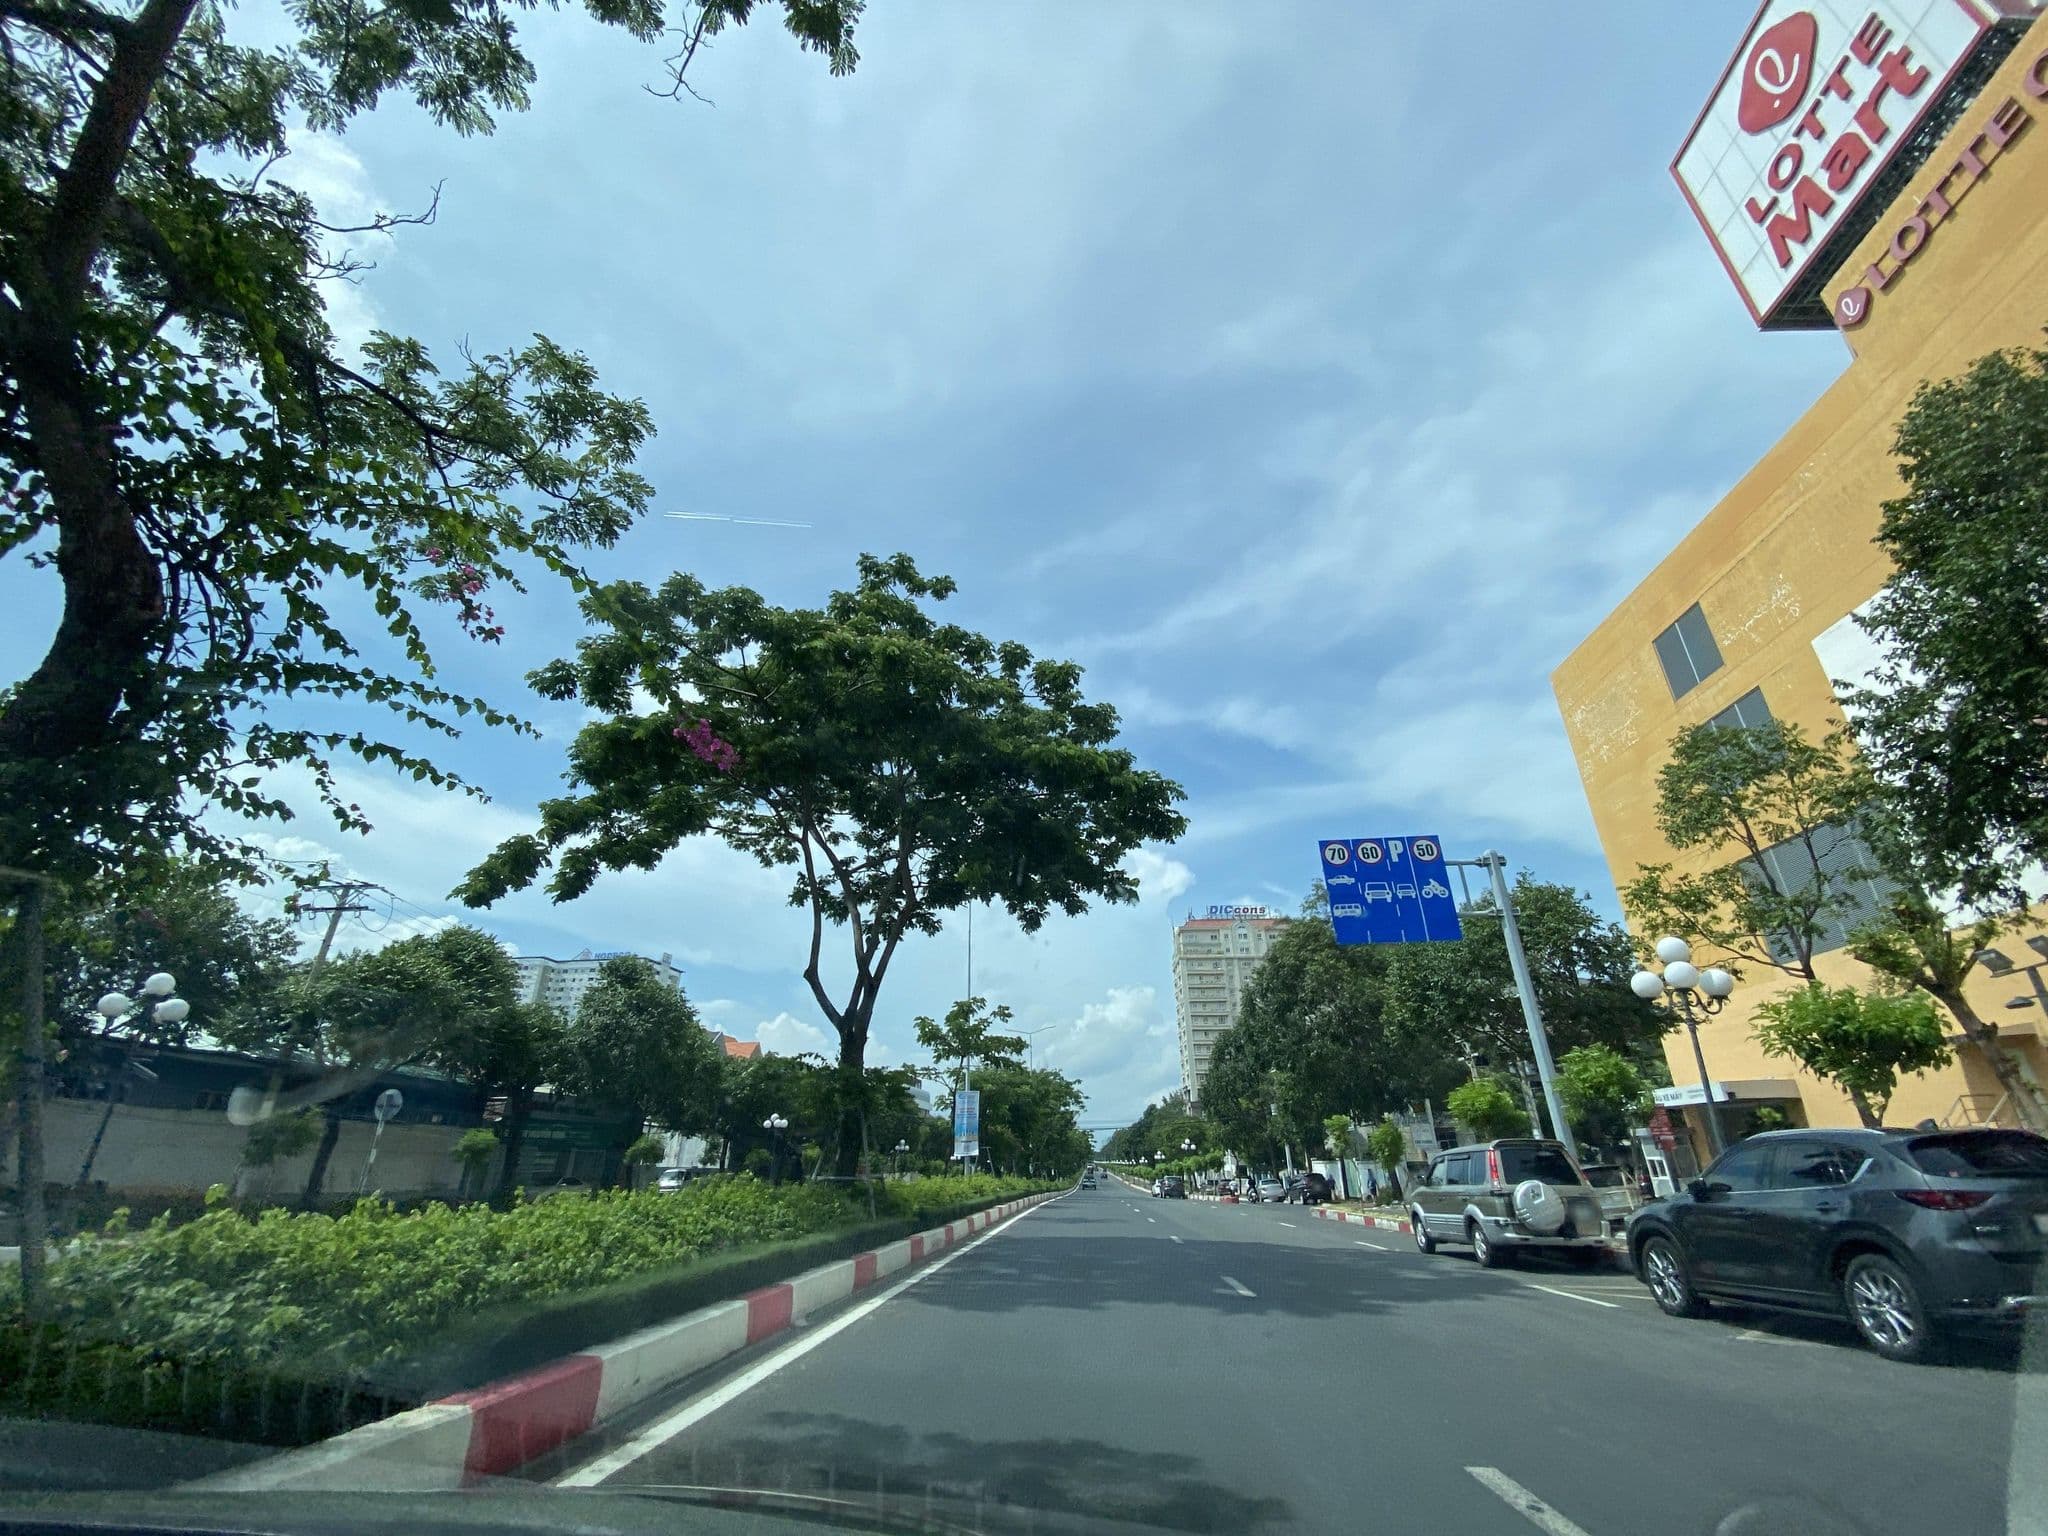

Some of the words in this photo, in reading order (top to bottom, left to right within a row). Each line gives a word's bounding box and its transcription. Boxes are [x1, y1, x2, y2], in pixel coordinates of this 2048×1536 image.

[1745, 12, 1893, 224] LOTTE
[1766, 46, 1931, 268] Mart
[1866, 97, 2032, 290] LOTTE
[1328, 848, 1346, 861] 70
[1361, 846, 1379, 860] 60
[1388, 840, 1404, 862] P
[1416, 844, 1434, 858] 50
